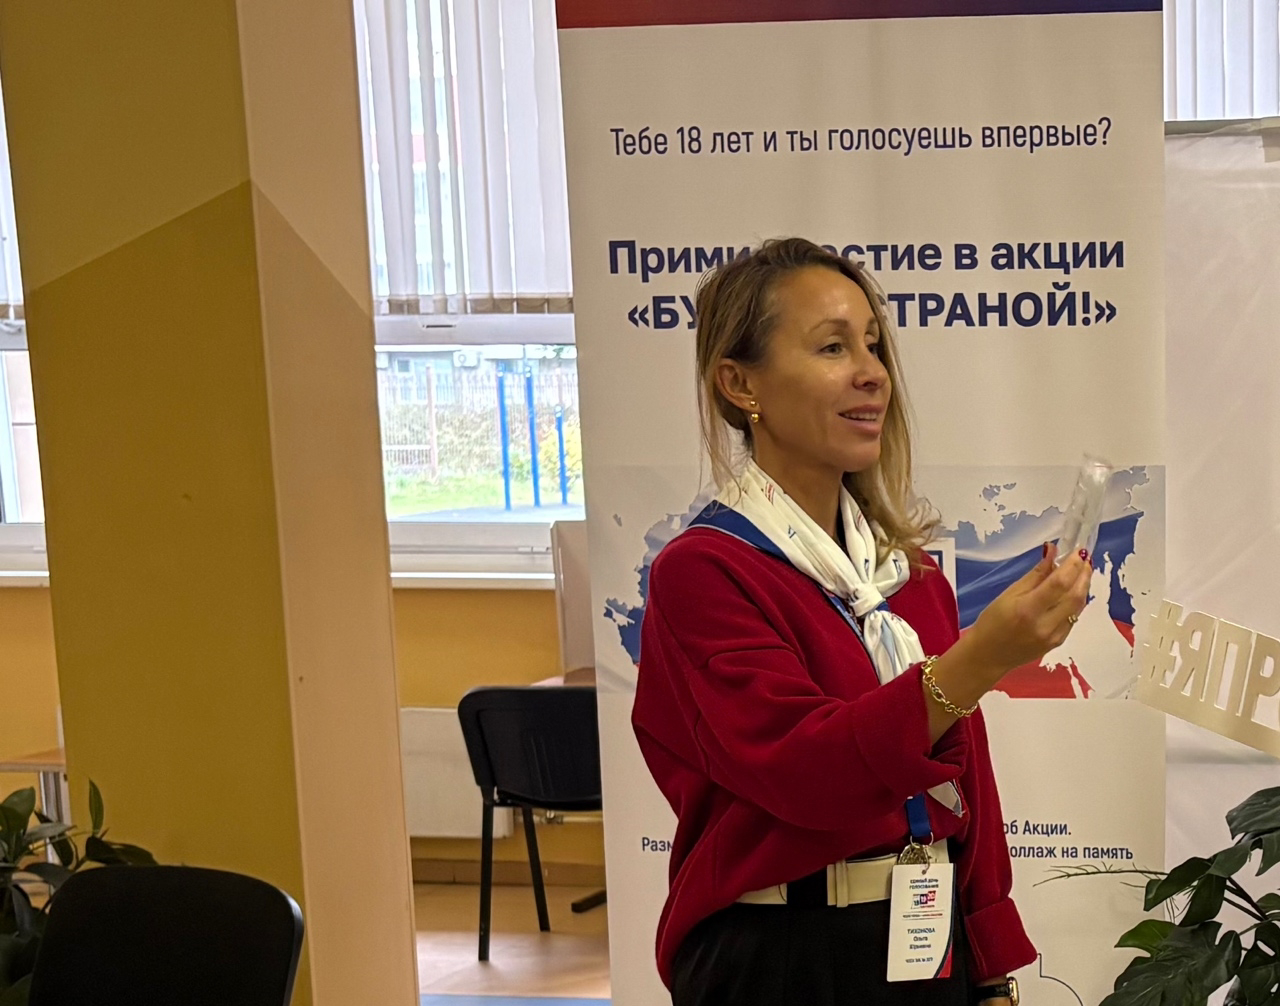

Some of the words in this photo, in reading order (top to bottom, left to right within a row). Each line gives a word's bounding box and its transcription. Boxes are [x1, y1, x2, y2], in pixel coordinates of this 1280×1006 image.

[609, 125, 669, 156] Тебе
[676, 125, 702, 155] 18
[710, 131, 755, 154] лет
[763, 130, 778, 153] и
[785, 129, 819, 153] ты
[827, 126, 973, 157] голосуешь
[981, 116, 1112, 154] впервые?
[953, 243, 979, 271] в
[990, 241, 1125, 276] акции
[875, 281, 1117, 328] ТРАНОЙ!»
[1022, 819, 1072, 838] Акции.
[1008, 845, 1058, 859] оллаж
[1061, 846, 1079, 859] на
[1082, 847, 1134, 861] память
